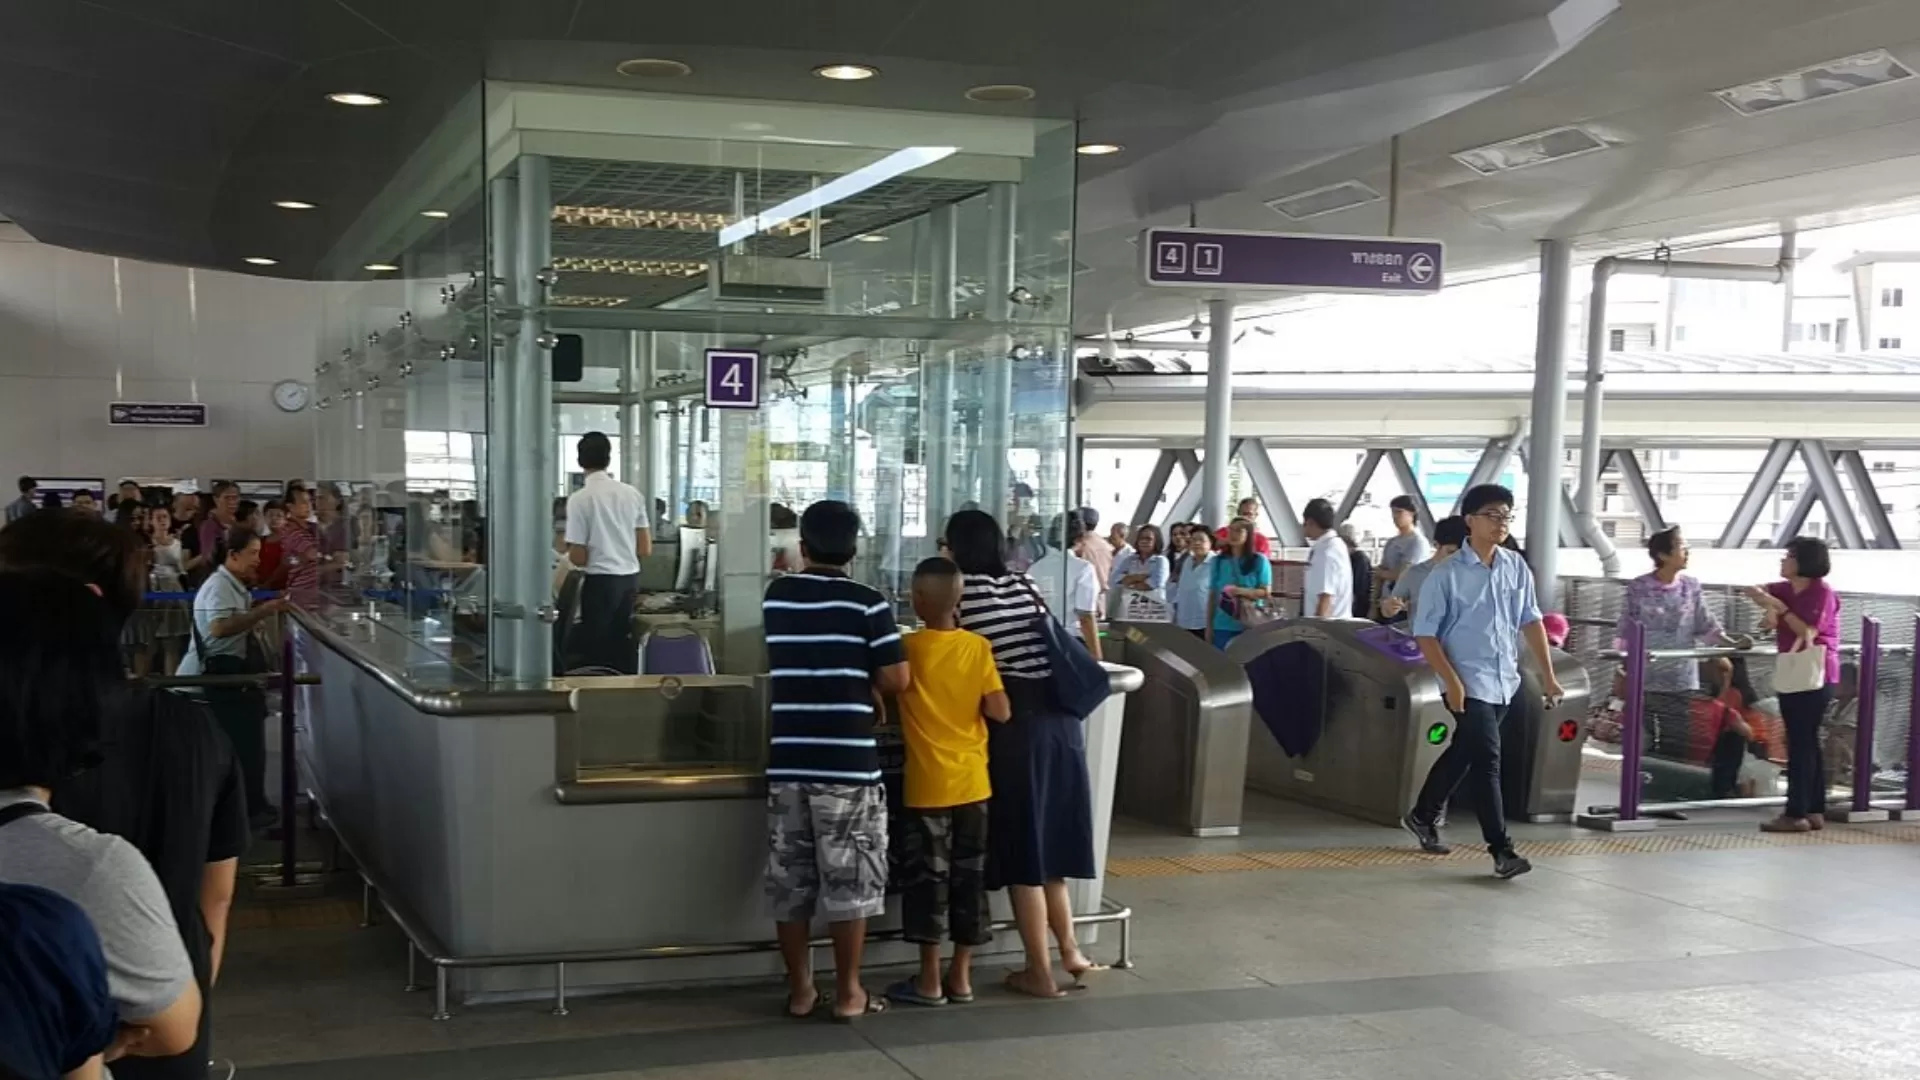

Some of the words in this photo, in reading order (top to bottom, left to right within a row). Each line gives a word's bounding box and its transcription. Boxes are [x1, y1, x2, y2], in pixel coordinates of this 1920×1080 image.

[1165, 246, 1179, 264] 4
[1203, 249, 1213, 265] 1
[1381, 271, 1402, 283] Exit
[720, 363, 744, 396] 4
